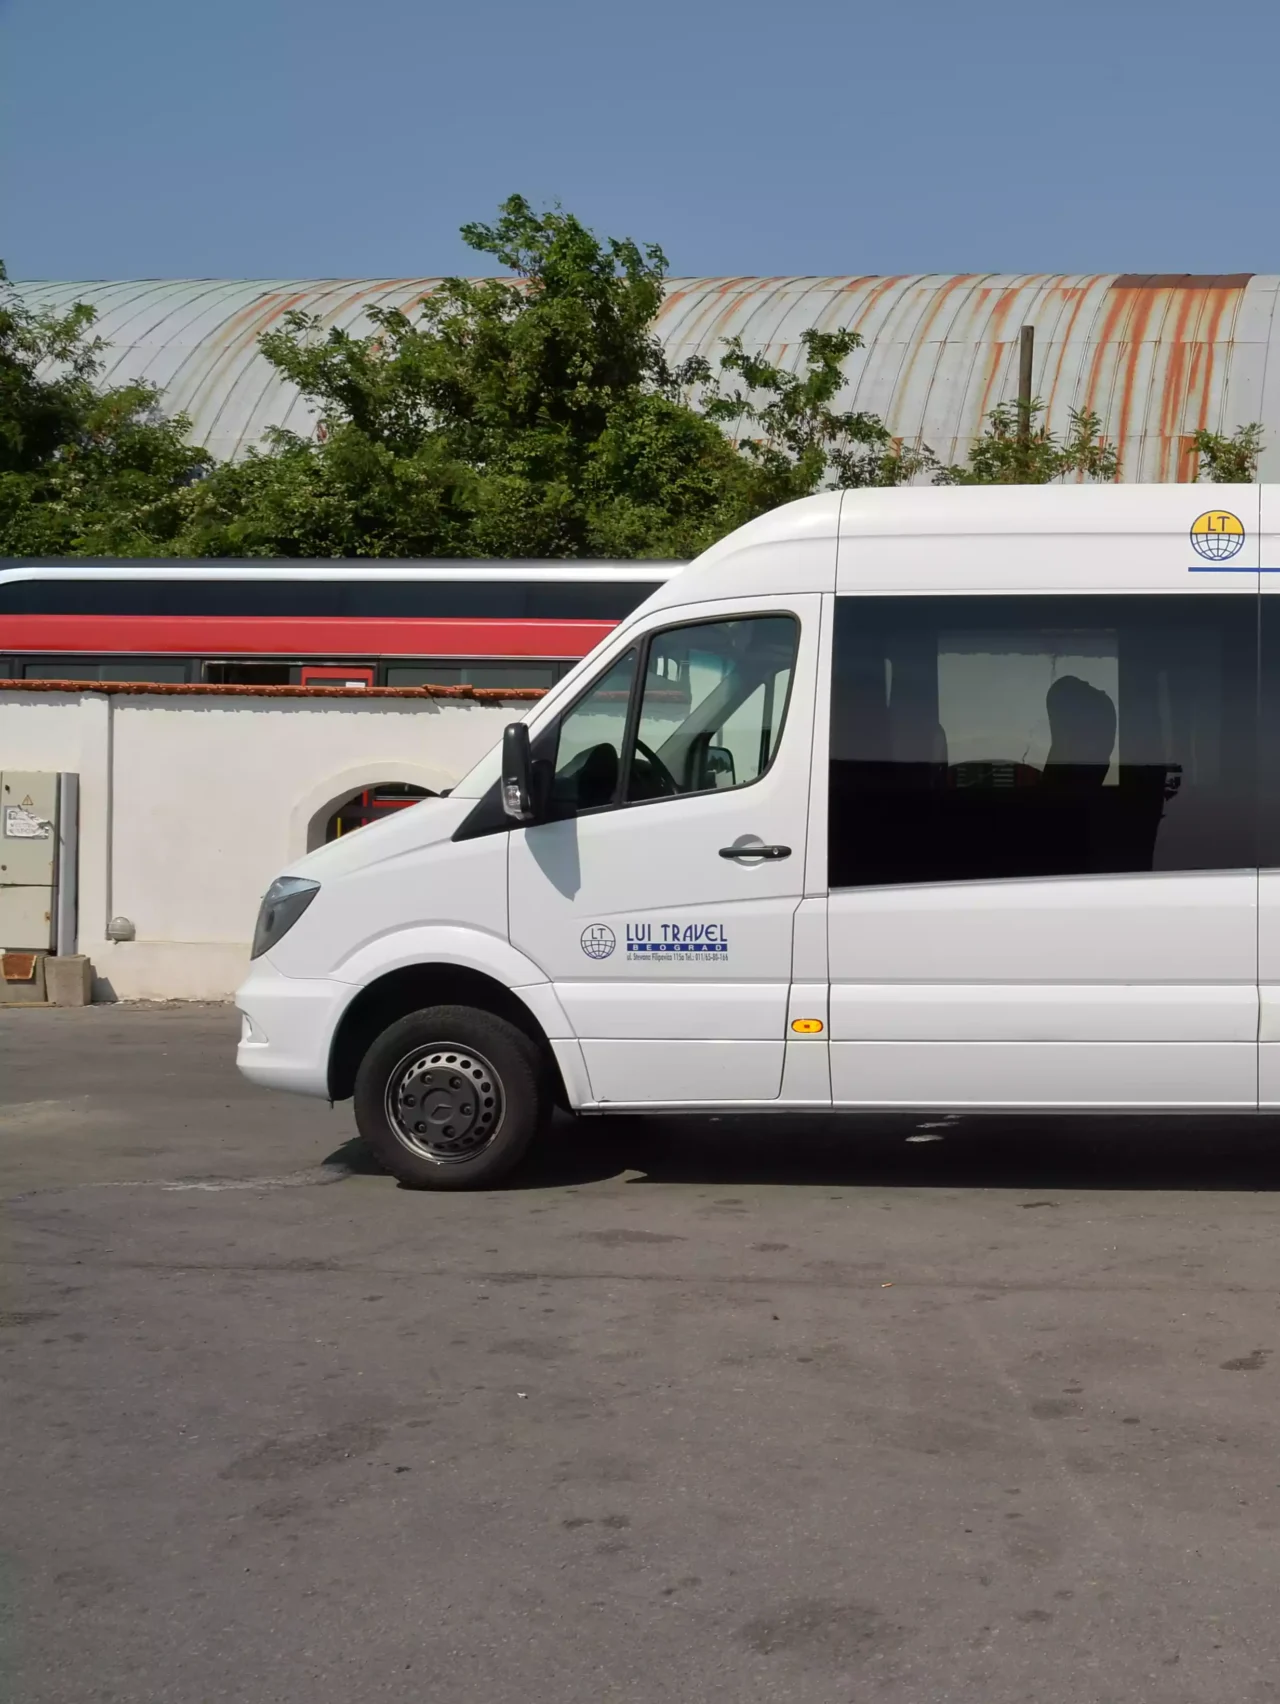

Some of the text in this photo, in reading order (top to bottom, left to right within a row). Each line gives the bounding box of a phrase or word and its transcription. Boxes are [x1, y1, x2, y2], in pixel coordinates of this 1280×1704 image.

[1207, 515, 1230, 532] LT
[591, 928, 606, 940] LT
[626, 923, 728, 942] LUI TRAVEL
